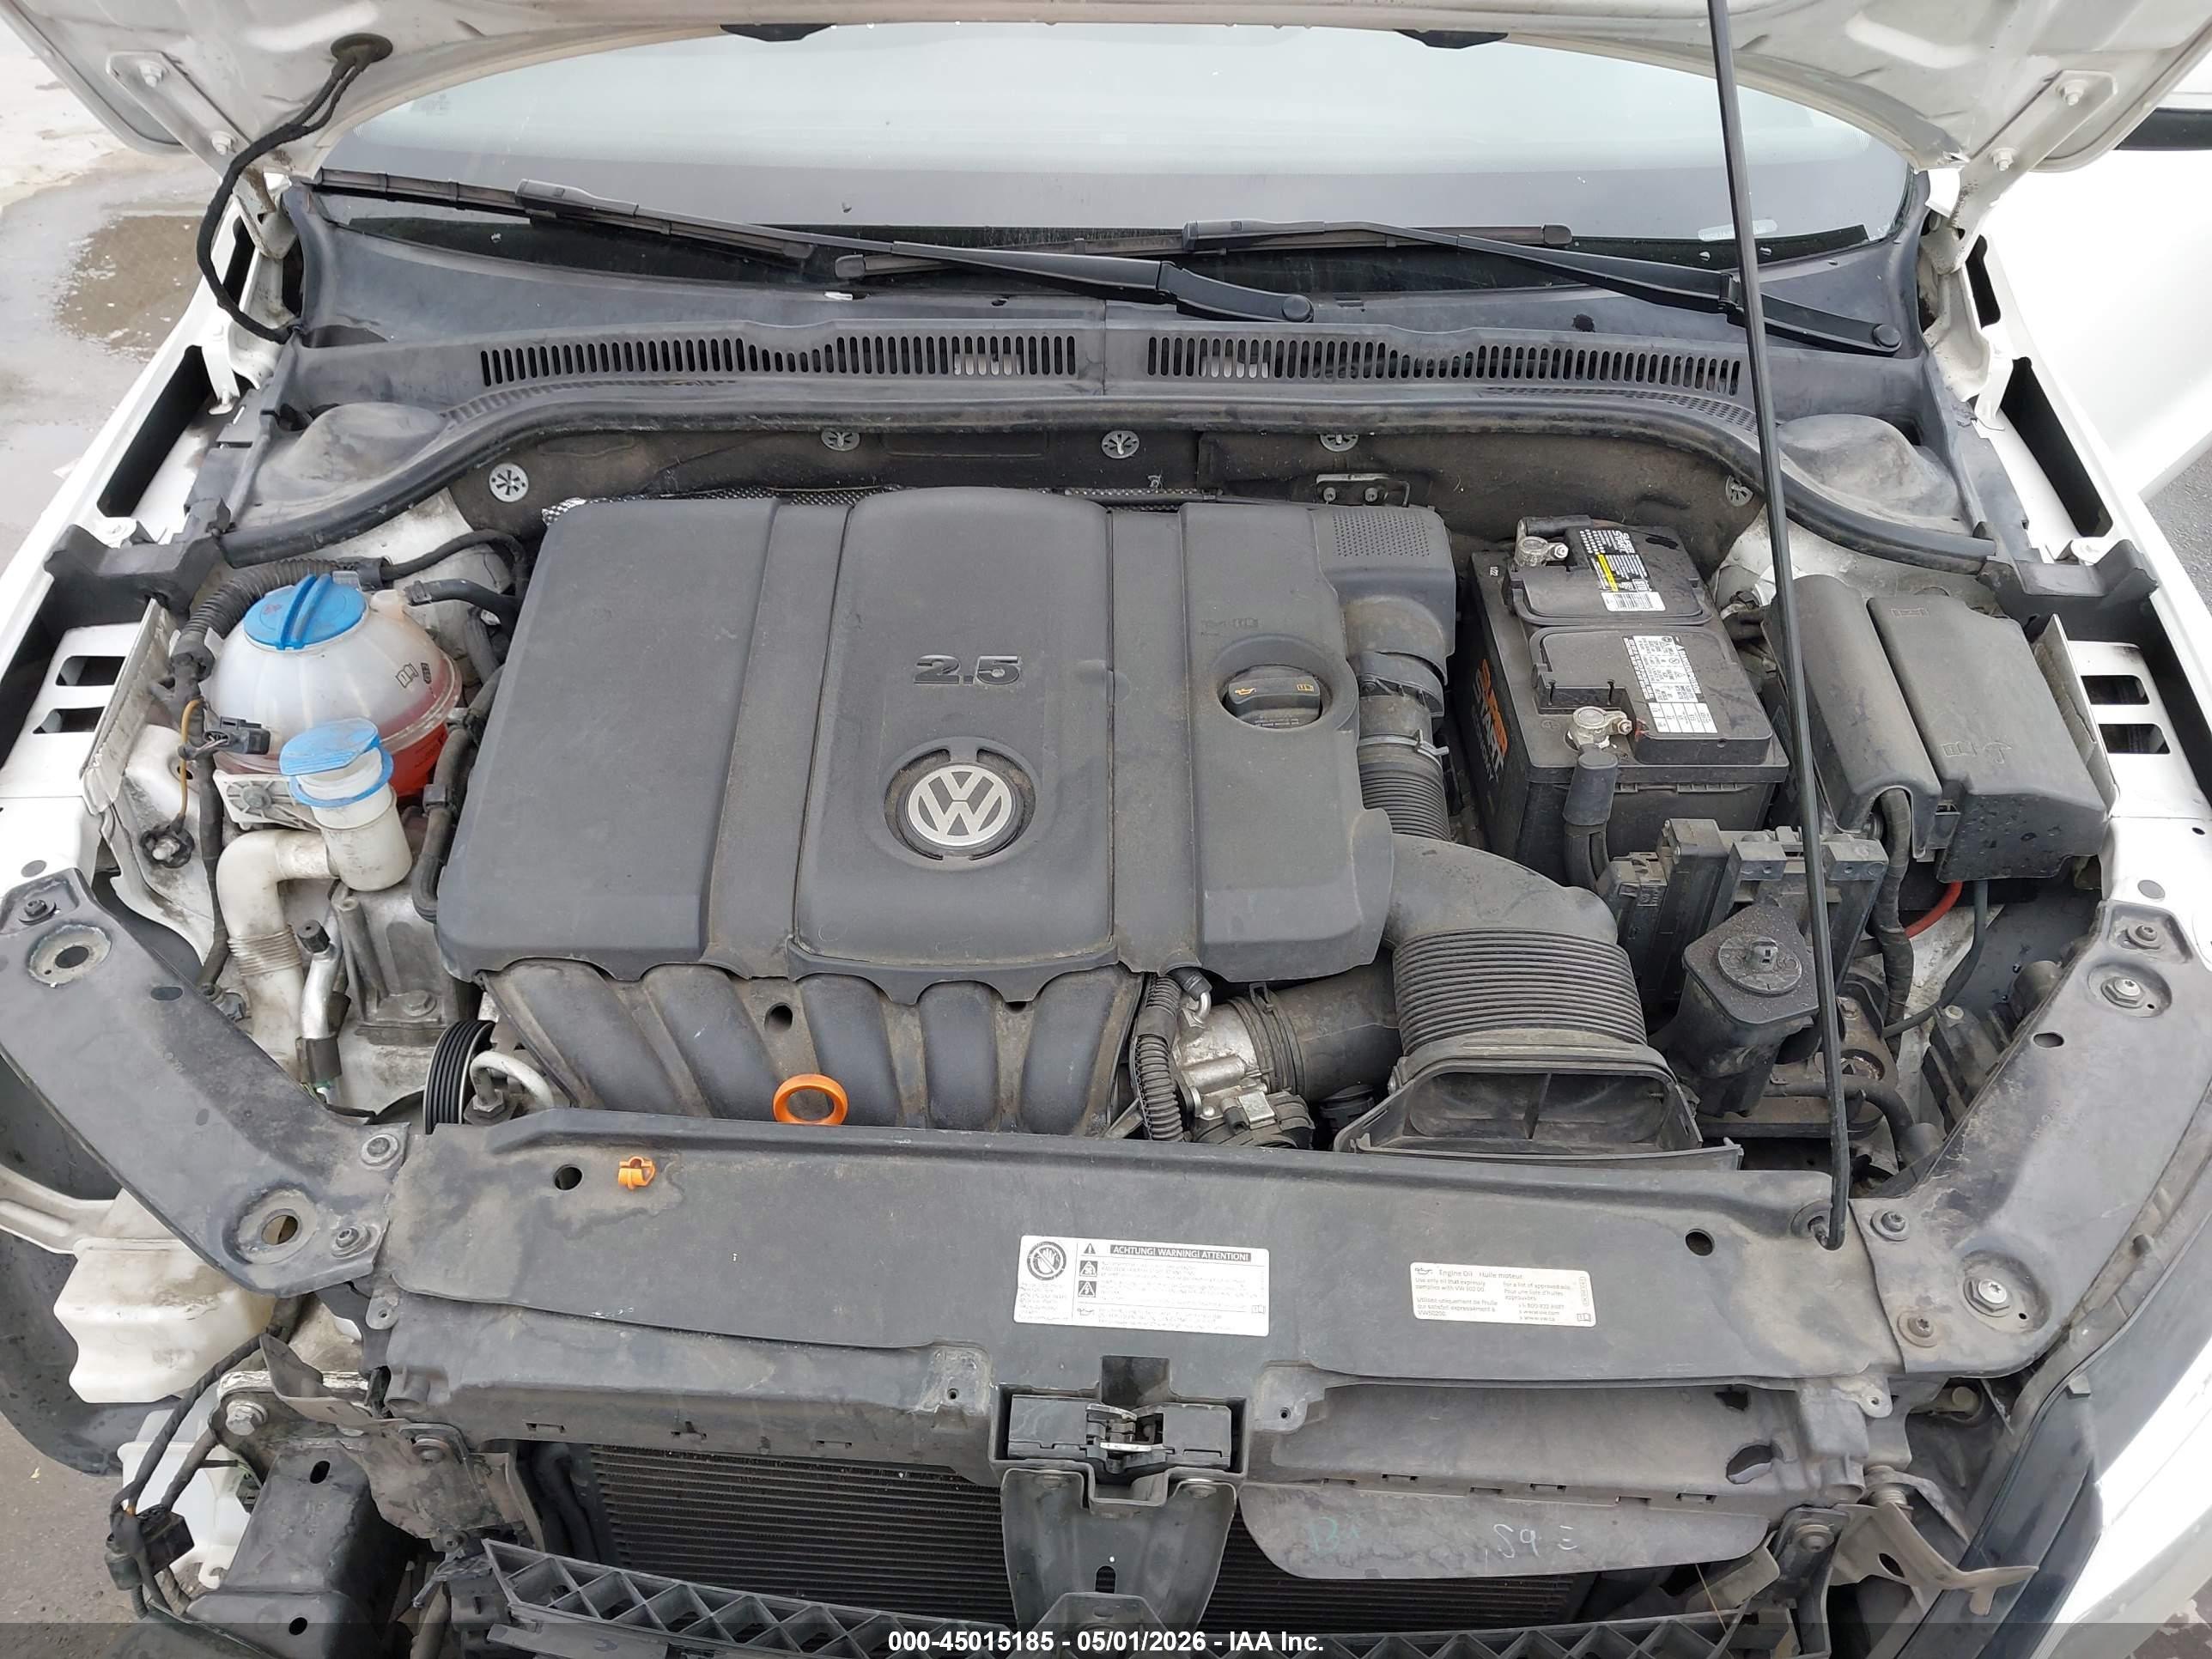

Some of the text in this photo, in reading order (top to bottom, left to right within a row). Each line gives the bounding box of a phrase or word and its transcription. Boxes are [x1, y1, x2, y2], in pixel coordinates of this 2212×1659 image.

[914, 655, 1020, 685] 2.5
[1482, 659, 1508, 757] SUPER
[1113, 1246, 1249, 1261] ACHTUNG! WARNING! ATTENTION!
[1438, 1269, 1462, 1278] Engine
